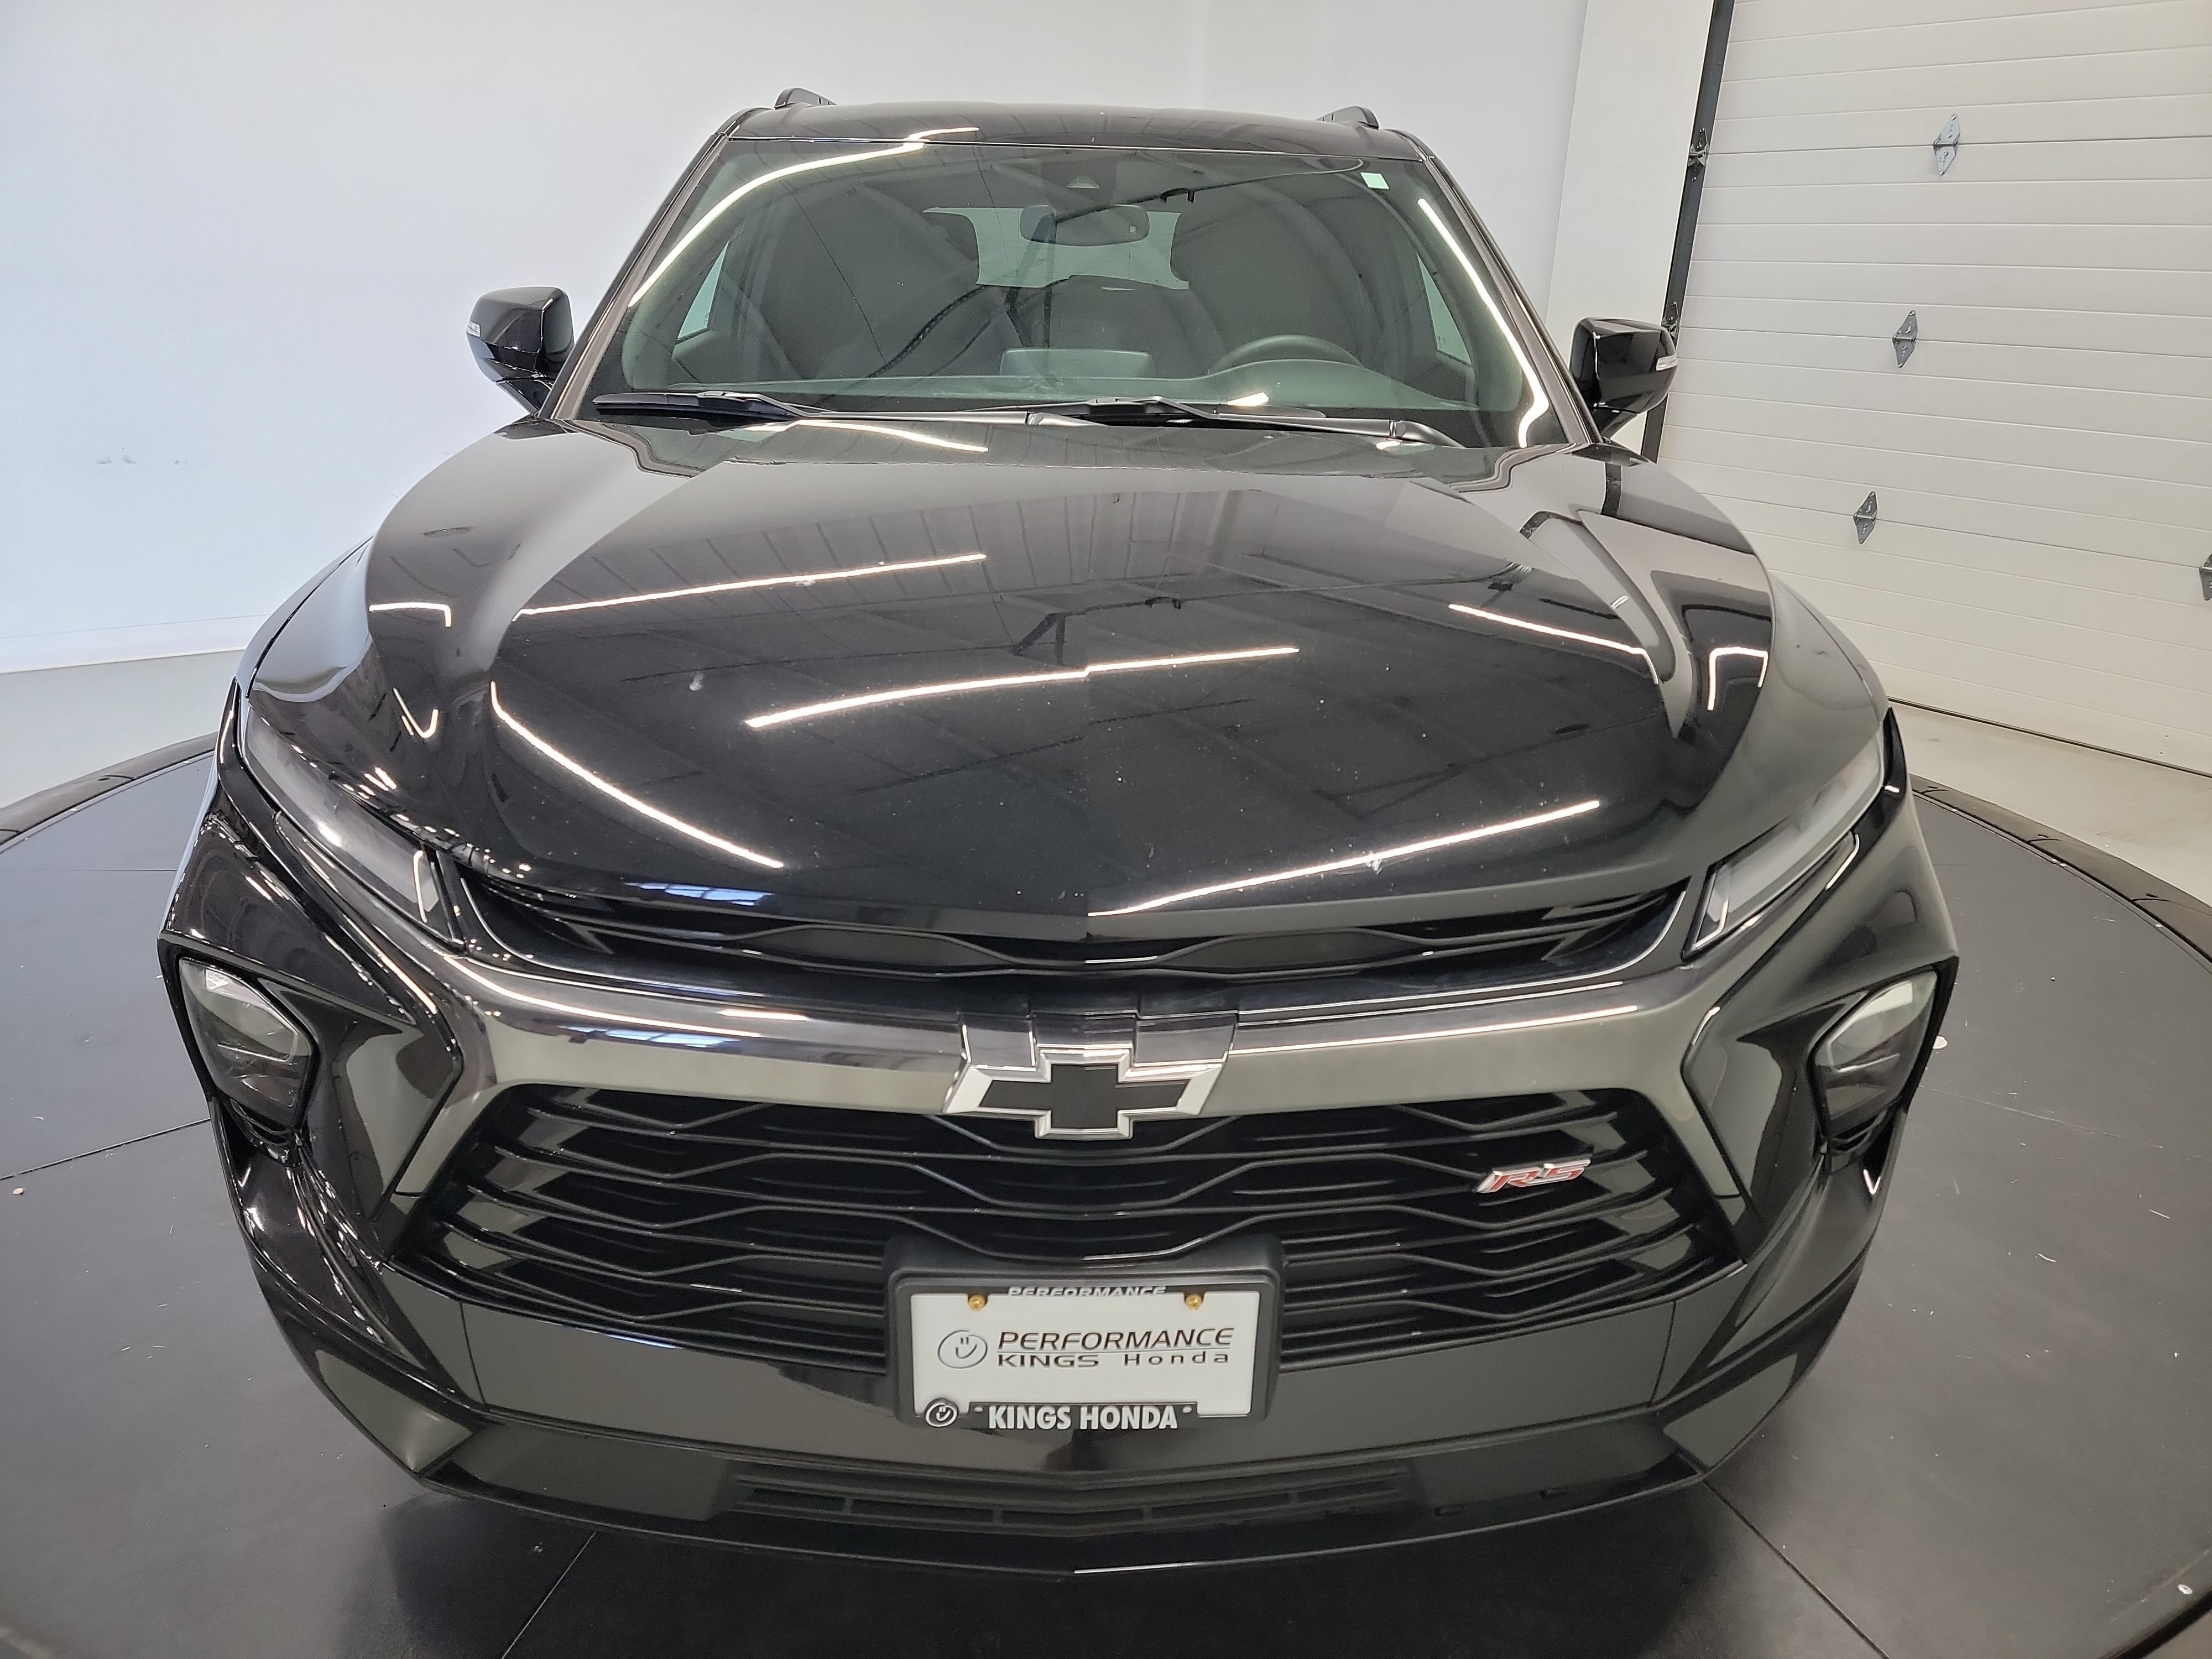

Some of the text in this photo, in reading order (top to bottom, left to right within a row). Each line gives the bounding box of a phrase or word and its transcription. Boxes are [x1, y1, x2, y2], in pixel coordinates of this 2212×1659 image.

[1008, 1286, 1167, 1297] PERFORMANCE
[997, 1328, 1235, 1351] PERFORMANCE
[998, 1351, 1229, 1368] KINGS Honda
[988, 1405, 1178, 1430] KINGS HONDA
